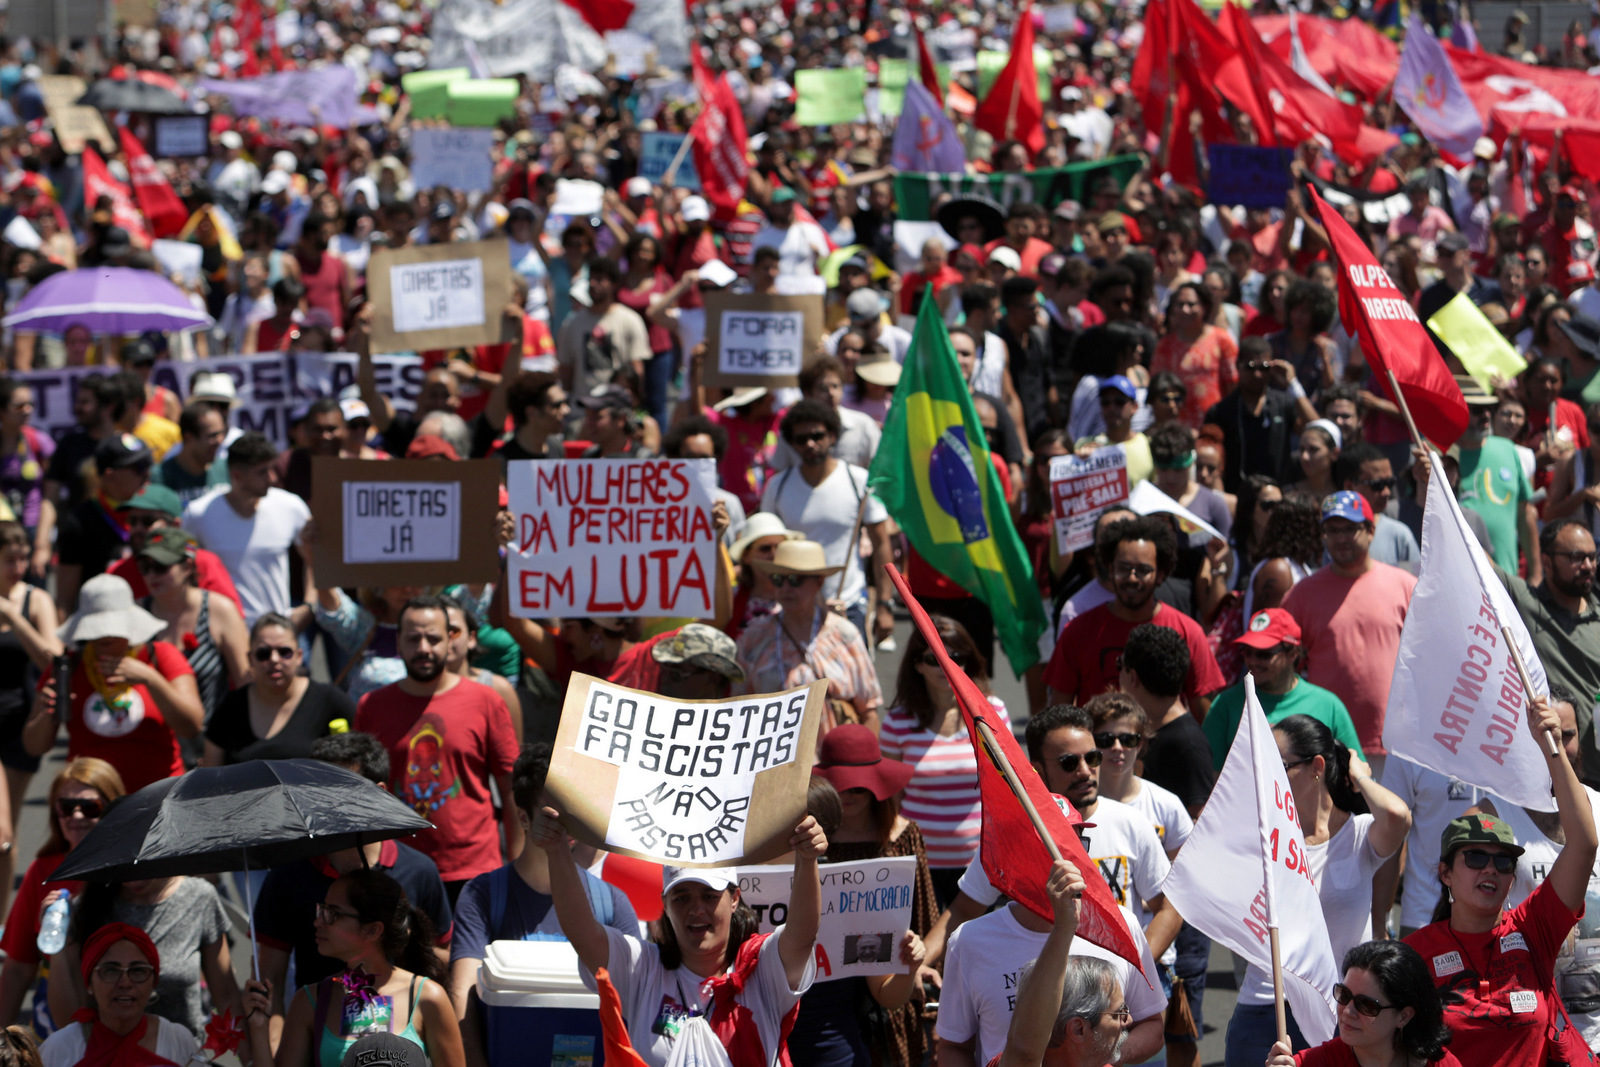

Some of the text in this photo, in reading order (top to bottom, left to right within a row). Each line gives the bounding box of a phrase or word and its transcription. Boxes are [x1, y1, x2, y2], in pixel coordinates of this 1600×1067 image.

[727, 316, 797, 336] FORA
[725, 348, 795, 368] TEMER
[537, 461, 690, 507] MULHERES
[383, 520, 414, 554] JÁ
[519, 505, 713, 554] DA PERIFERIA
[519, 547, 712, 612] EM LUTA
[588, 690, 806, 741] GOLPISTAS
[583, 724, 795, 778] FASCISTAS
[645, 781, 722, 818] NÃO
[617, 796, 750, 860] PASSARÃO
[738, 877, 761, 893] OR
[751, 902, 789, 926] TO
[813, 943, 832, 978] A
